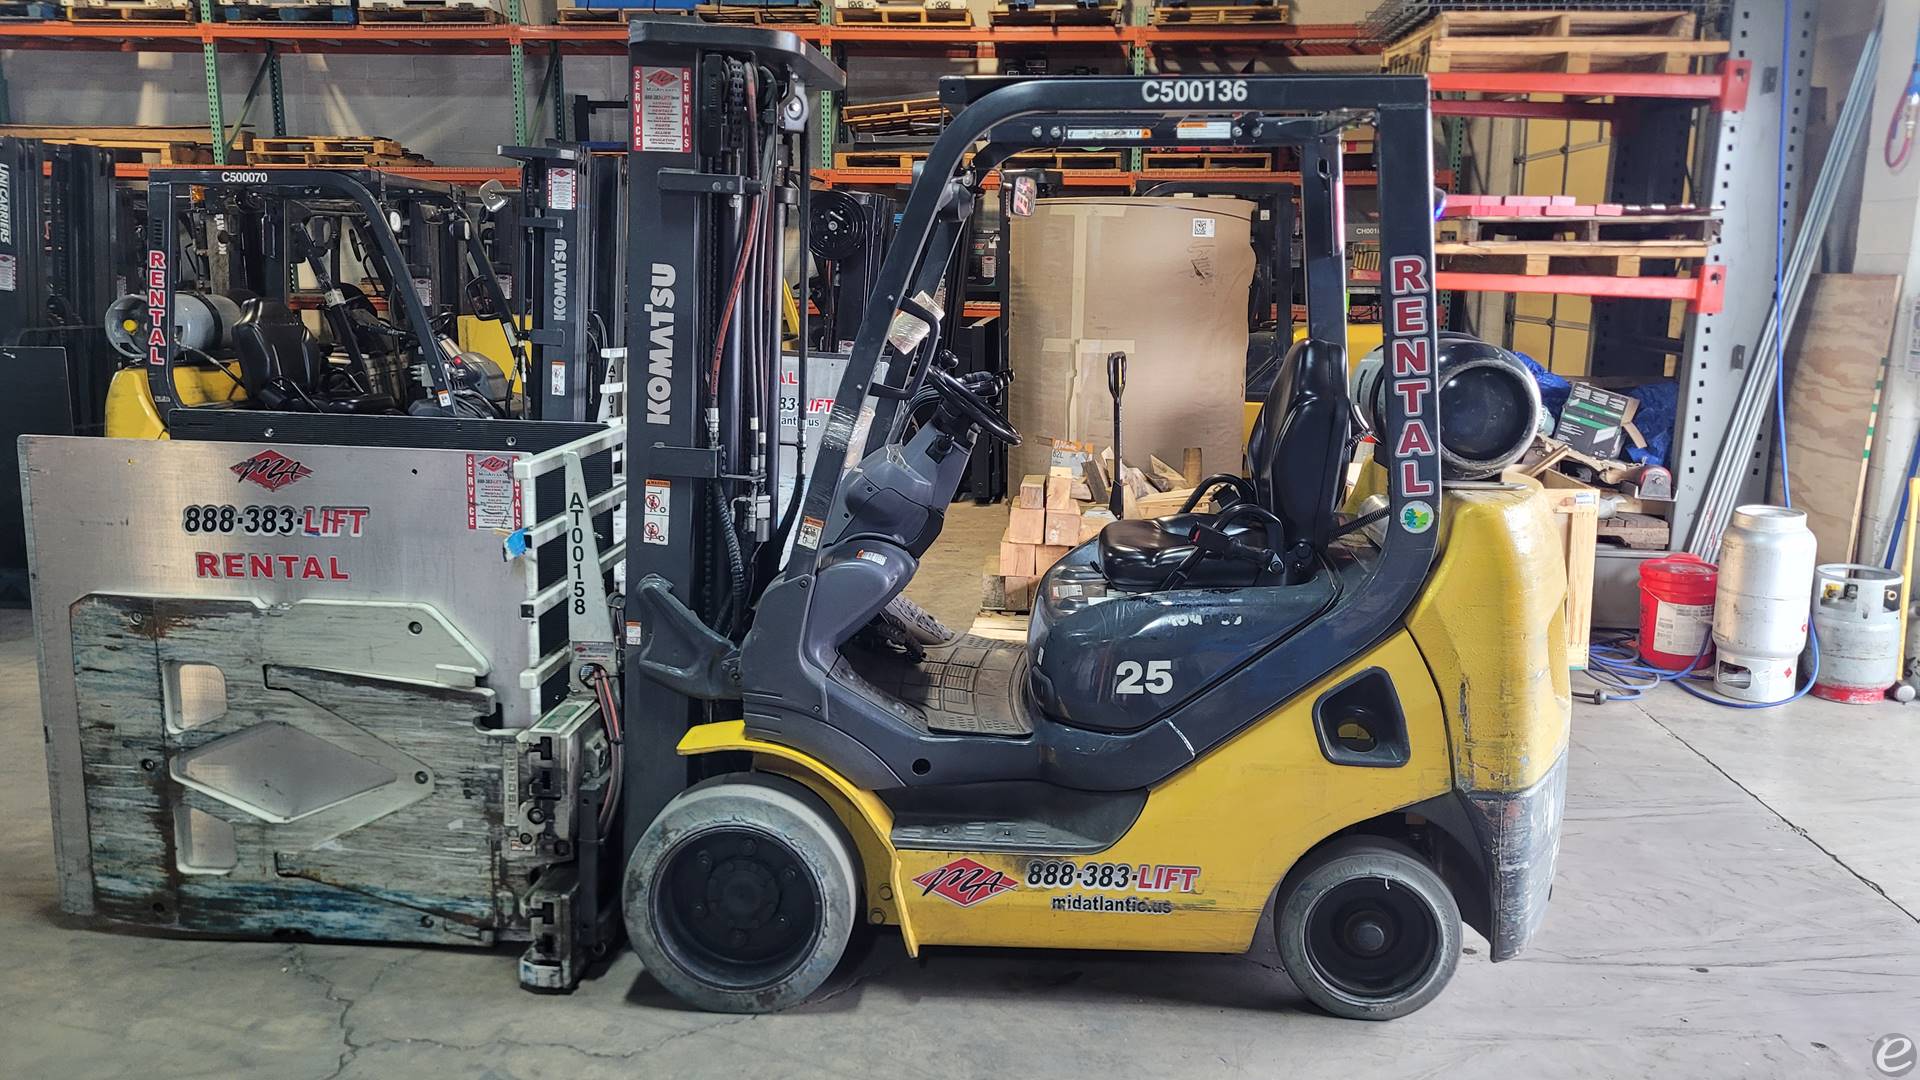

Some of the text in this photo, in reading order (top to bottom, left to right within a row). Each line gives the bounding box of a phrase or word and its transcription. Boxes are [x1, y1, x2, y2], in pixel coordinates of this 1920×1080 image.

[1142, 80, 1248, 102] C500136
[221, 171, 268, 183] C500070
[148, 250, 166, 365] RENTAL
[551, 238, 567, 321] KOMATSU
[644, 262, 677, 425] KOMATSU
[1390, 256, 1435, 497] RENTAL
[196, 553, 350, 580] RENTAL
[569, 492, 585, 615] AT00158
[1116, 660, 1173, 695] 25
[1052, 895, 1172, 914] midatlantic.us
